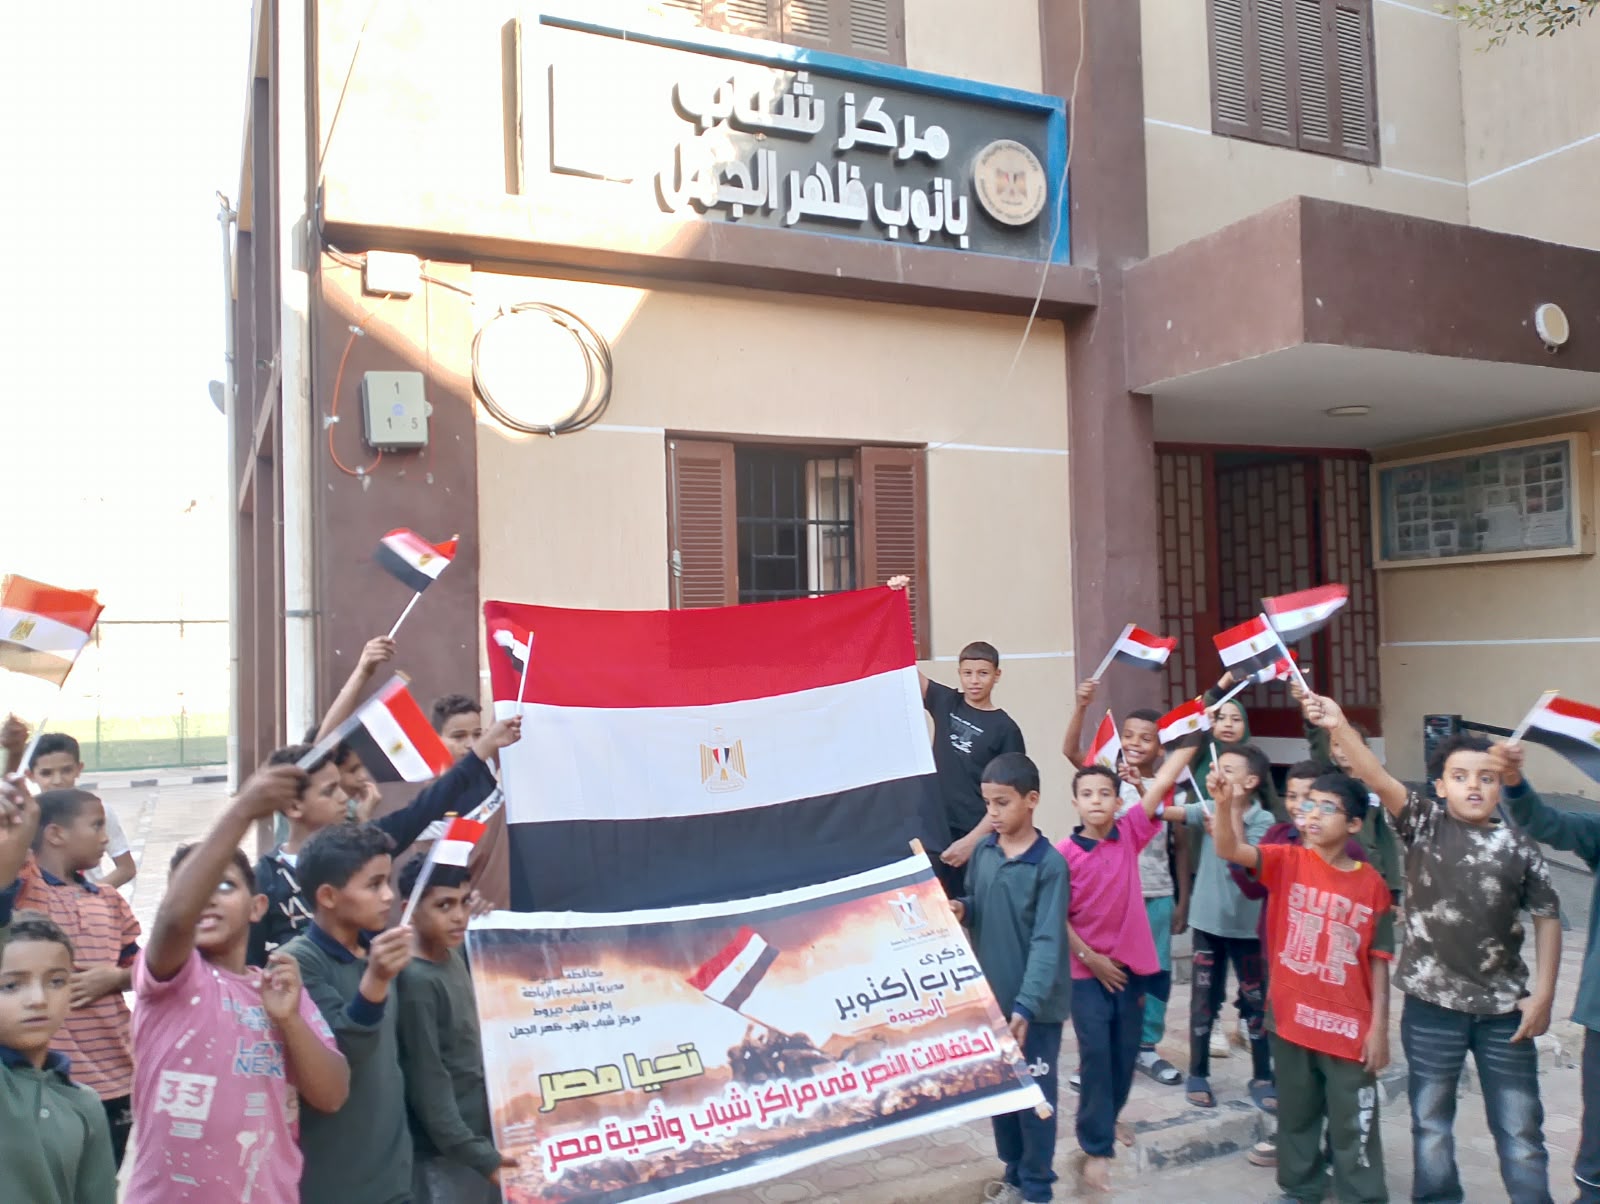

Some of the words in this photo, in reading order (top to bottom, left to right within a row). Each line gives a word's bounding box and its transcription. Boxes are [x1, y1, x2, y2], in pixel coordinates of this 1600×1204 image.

[671, 70, 825, 137] شباب
[838, 92, 949, 160] مركز
[786, 161, 869, 226] ظهر
[874, 177, 969, 249] بانوب
[411, 417, 418, 430] 5
[1288, 882, 1374, 929] SURF
[919, 943, 966, 966] ذكرى
[562, 982, 596, 995] الشباب
[597, 982, 625, 994] مديرية
[920, 964, 984, 997] حرب
[566, 1000, 590, 1014] شباب
[592, 1014, 615, 1028] شباب
[617, 1014, 642, 1026] مركز
[886, 998, 944, 1024] المجيدة
[509, 1024, 537, 1040] الجمل
[540, 1022, 563, 1036] ظهر
[622, 1042, 705, 1093] تحيا
[912, 1031, 996, 1072] احتفالات
[538, 1063, 625, 1114] مصر
[861, 1052, 912, 1093] النصر
[691, 1088, 753, 1137] شباب
[754, 1082, 818, 1123] مراكز
[605, 1105, 686, 1156] وأندية
[547, 1133, 603, 1172] مصر
